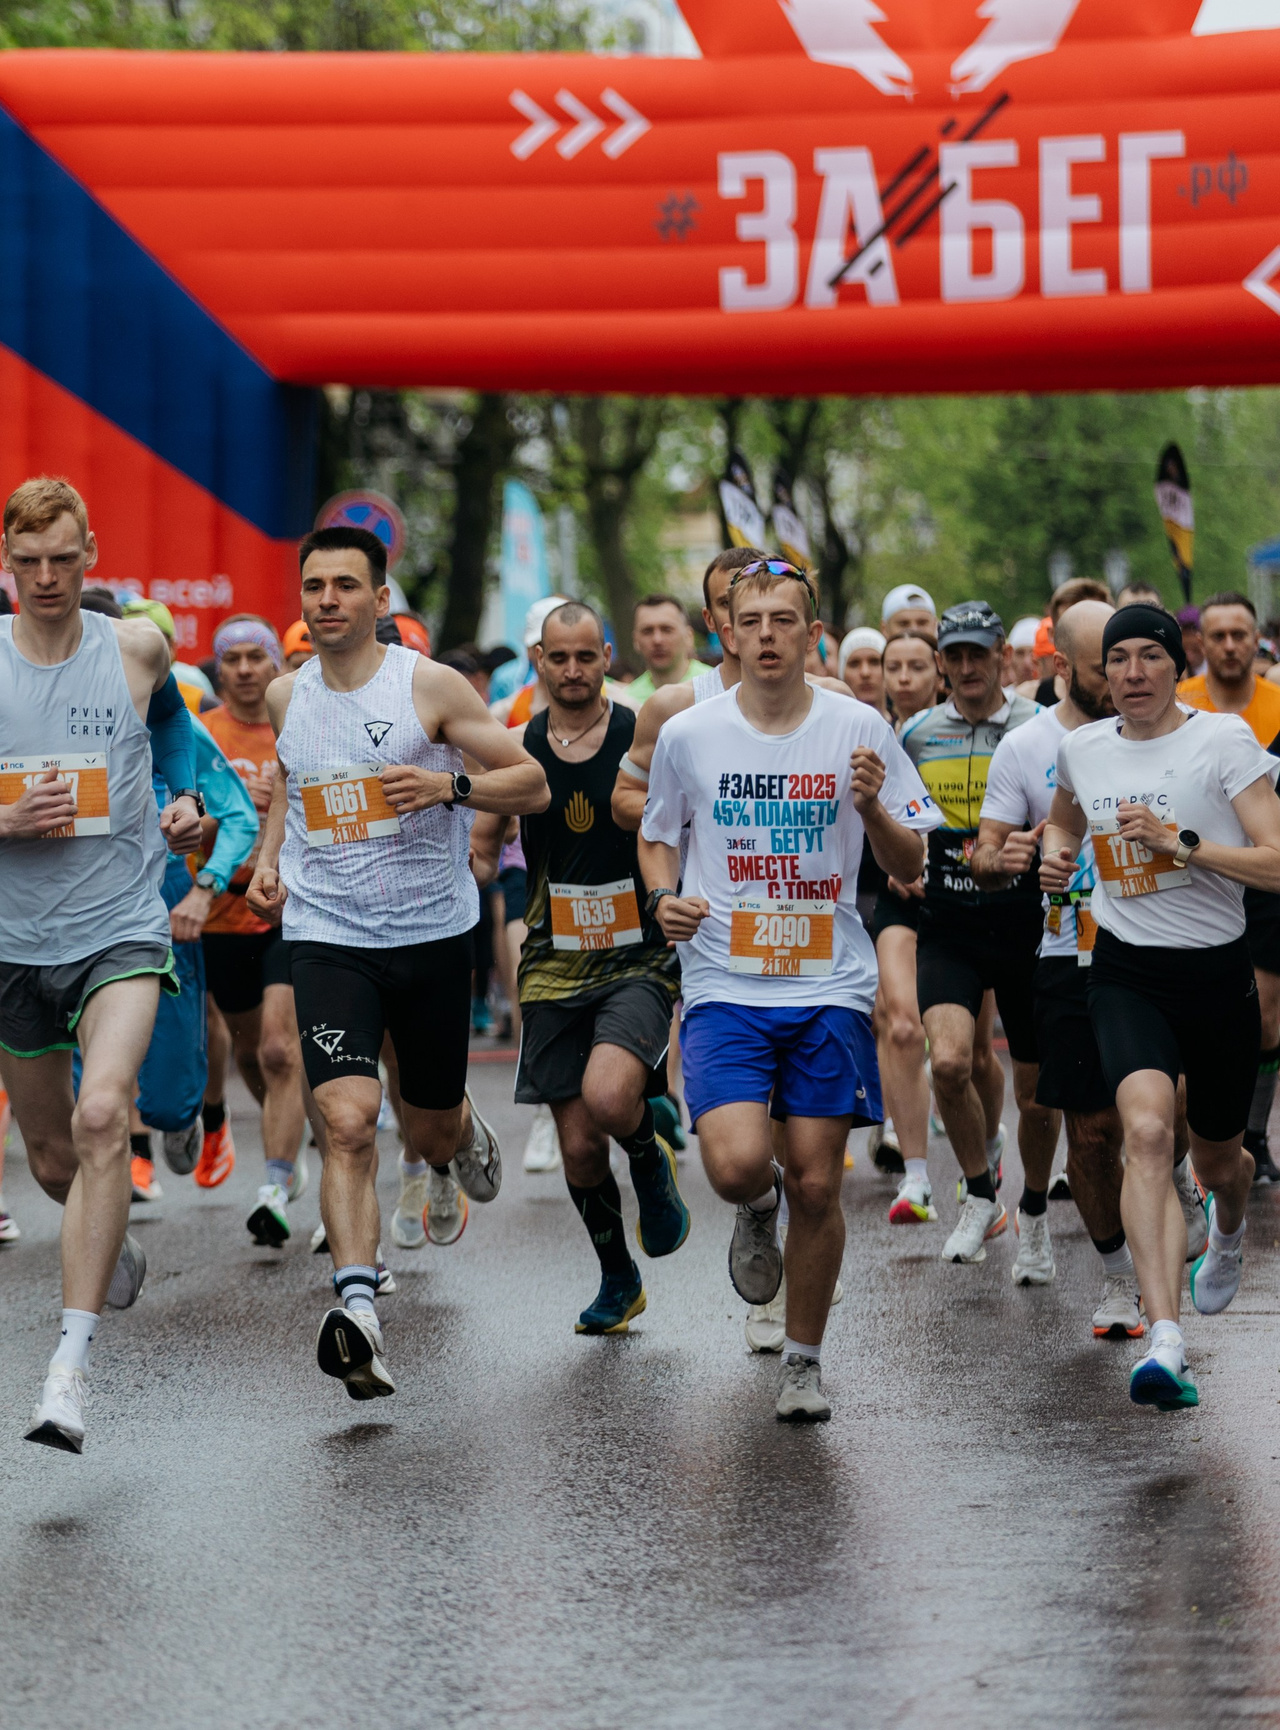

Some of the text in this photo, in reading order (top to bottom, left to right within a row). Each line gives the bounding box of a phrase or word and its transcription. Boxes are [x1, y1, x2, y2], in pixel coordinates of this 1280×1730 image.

[70, 707, 113, 719] PVLN
[70, 725, 115, 736] CREW
[9, 762, 25, 770] ПСБ
[320, 781, 369, 817] 1661
[718, 773, 837, 800] #ЗАБЕГ2025
[712, 799, 840, 827] 45% ПЛАНЕТЫ
[771, 827, 825, 854] БЕГУТ
[727, 855, 802, 882] ВМЕСТЕ
[792, 873, 843, 904] ТОБОЙ
[570, 897, 617, 927] 1635
[752, 914, 811, 948] 2090
